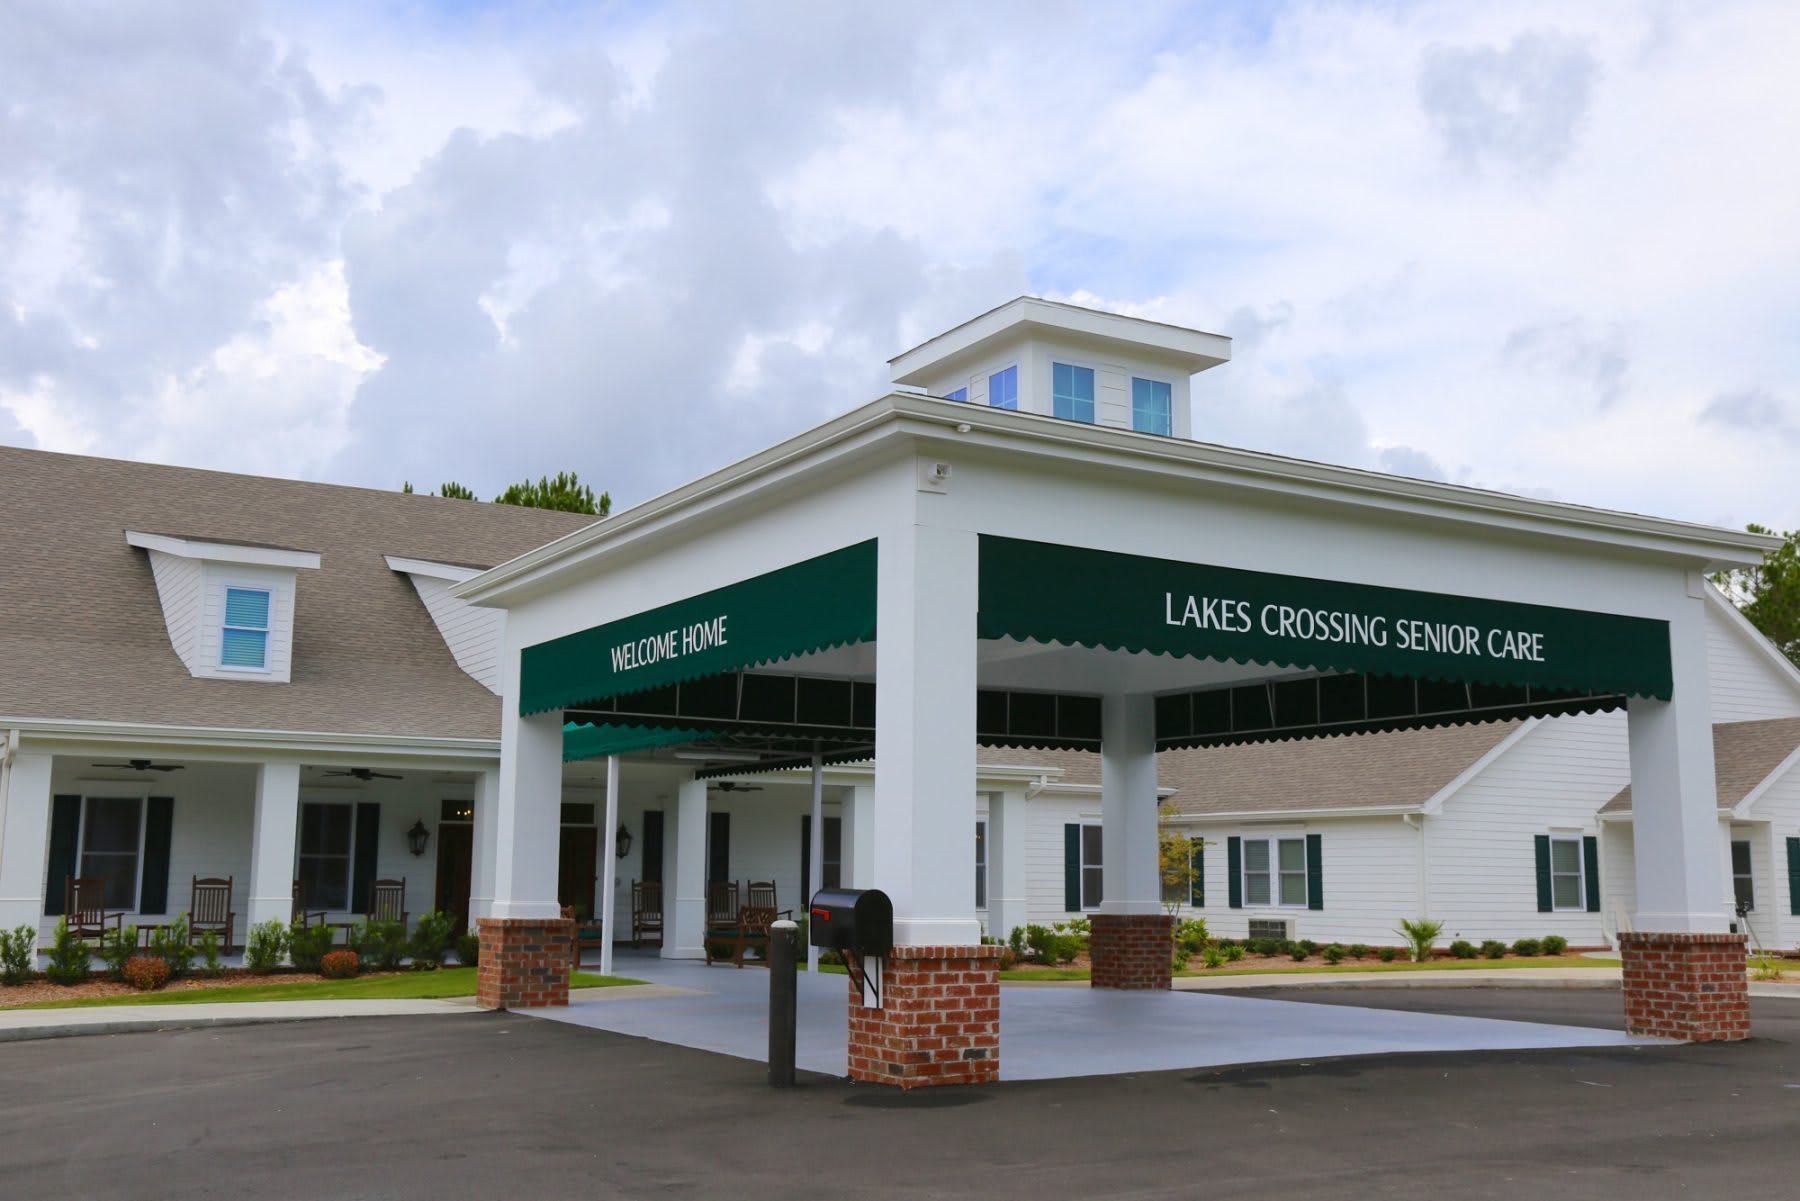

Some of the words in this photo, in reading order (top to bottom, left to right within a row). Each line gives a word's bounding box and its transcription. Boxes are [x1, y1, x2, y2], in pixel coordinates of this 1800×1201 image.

[610, 629, 678, 673] WELCOME
[682, 615, 728, 656] HOME
[1165, 592, 1252, 633] LAKES
[1260, 604, 1387, 647] CROSSING
[1396, 619, 1481, 656] SENIOR
[1487, 629, 1546, 662] CARE
